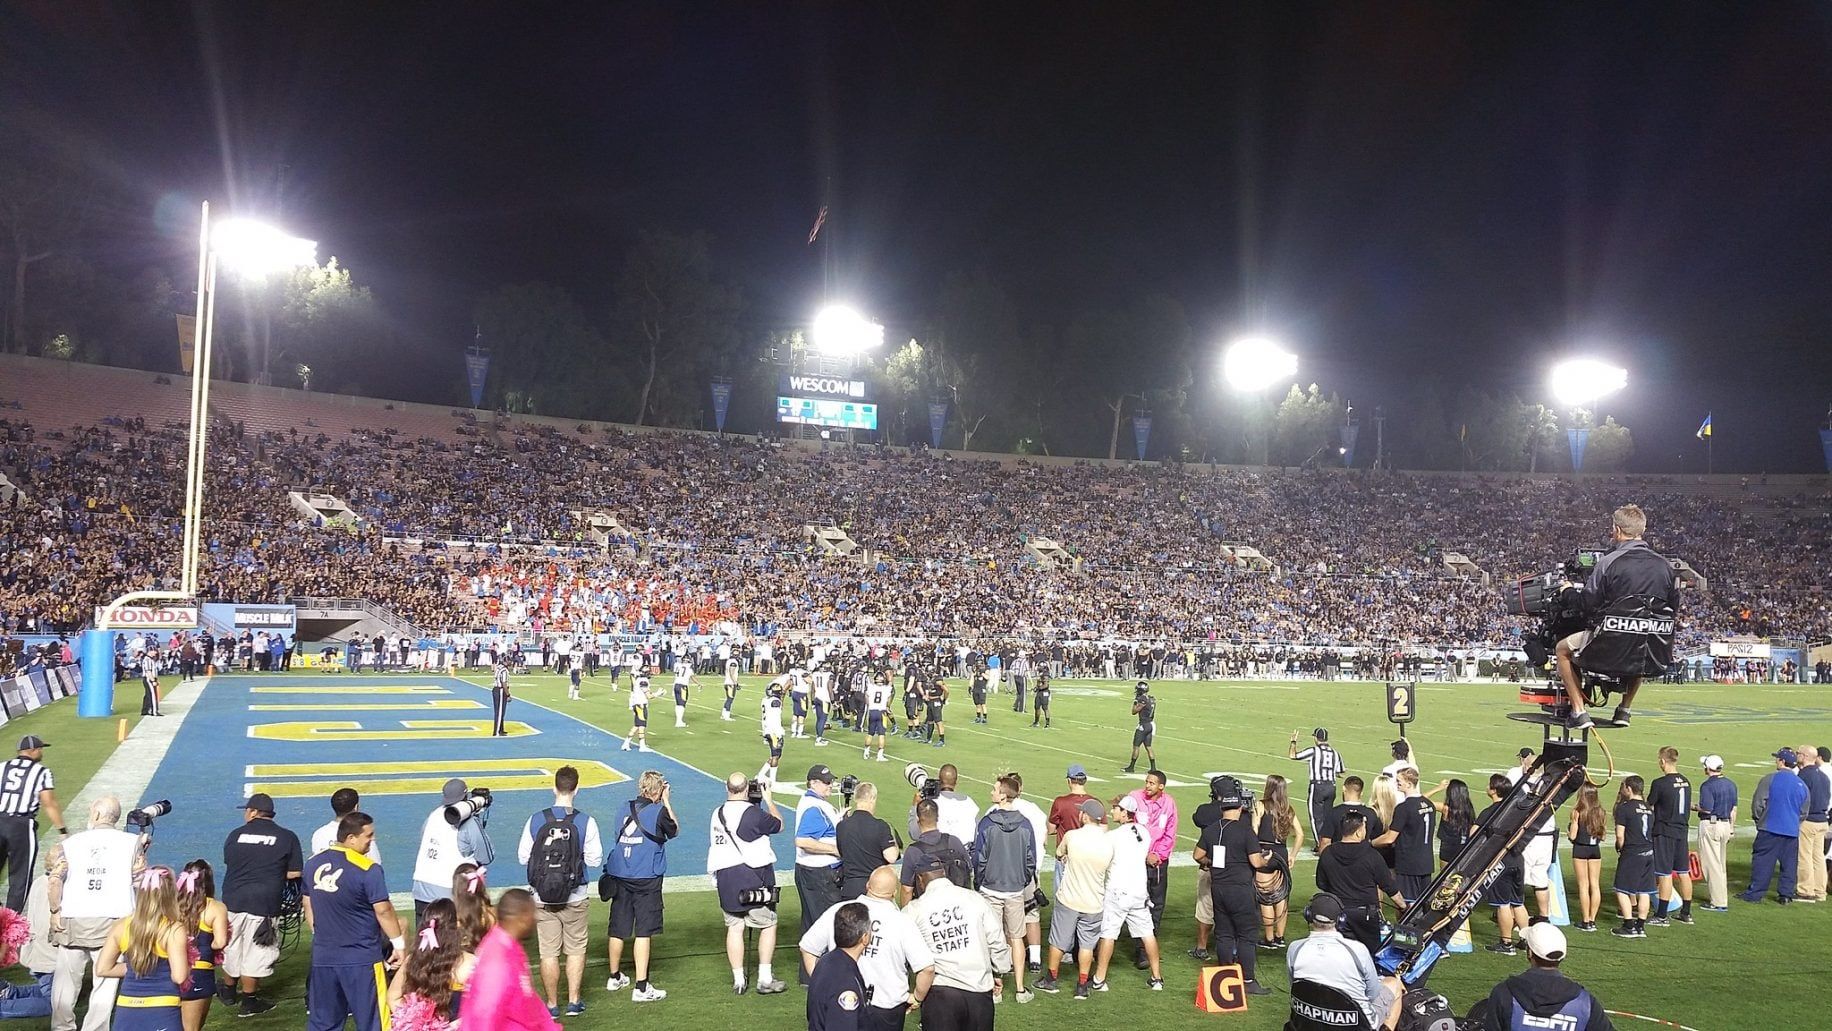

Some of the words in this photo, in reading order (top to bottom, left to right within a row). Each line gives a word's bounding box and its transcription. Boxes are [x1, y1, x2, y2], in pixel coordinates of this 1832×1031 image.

[789, 376, 849, 394] WESCOM
[234, 613, 269, 624] MUSCLE
[1606, 618, 1673, 633] CHAPMAN
[608, 635, 630, 644] MUSCLE
[874, 691, 882, 704] 8
[1393, 687, 1409, 715] 2
[4, 767, 26, 791] S
[1678, 787, 1686, 815] 1
[237, 833, 278, 846] ESPN
[313, 862, 344, 893] Cal
[929, 906, 964, 927] CSC
[931, 923, 969, 943] EVENT
[935, 937, 970, 954] STAFF
[1210, 969, 1245, 1010] G
